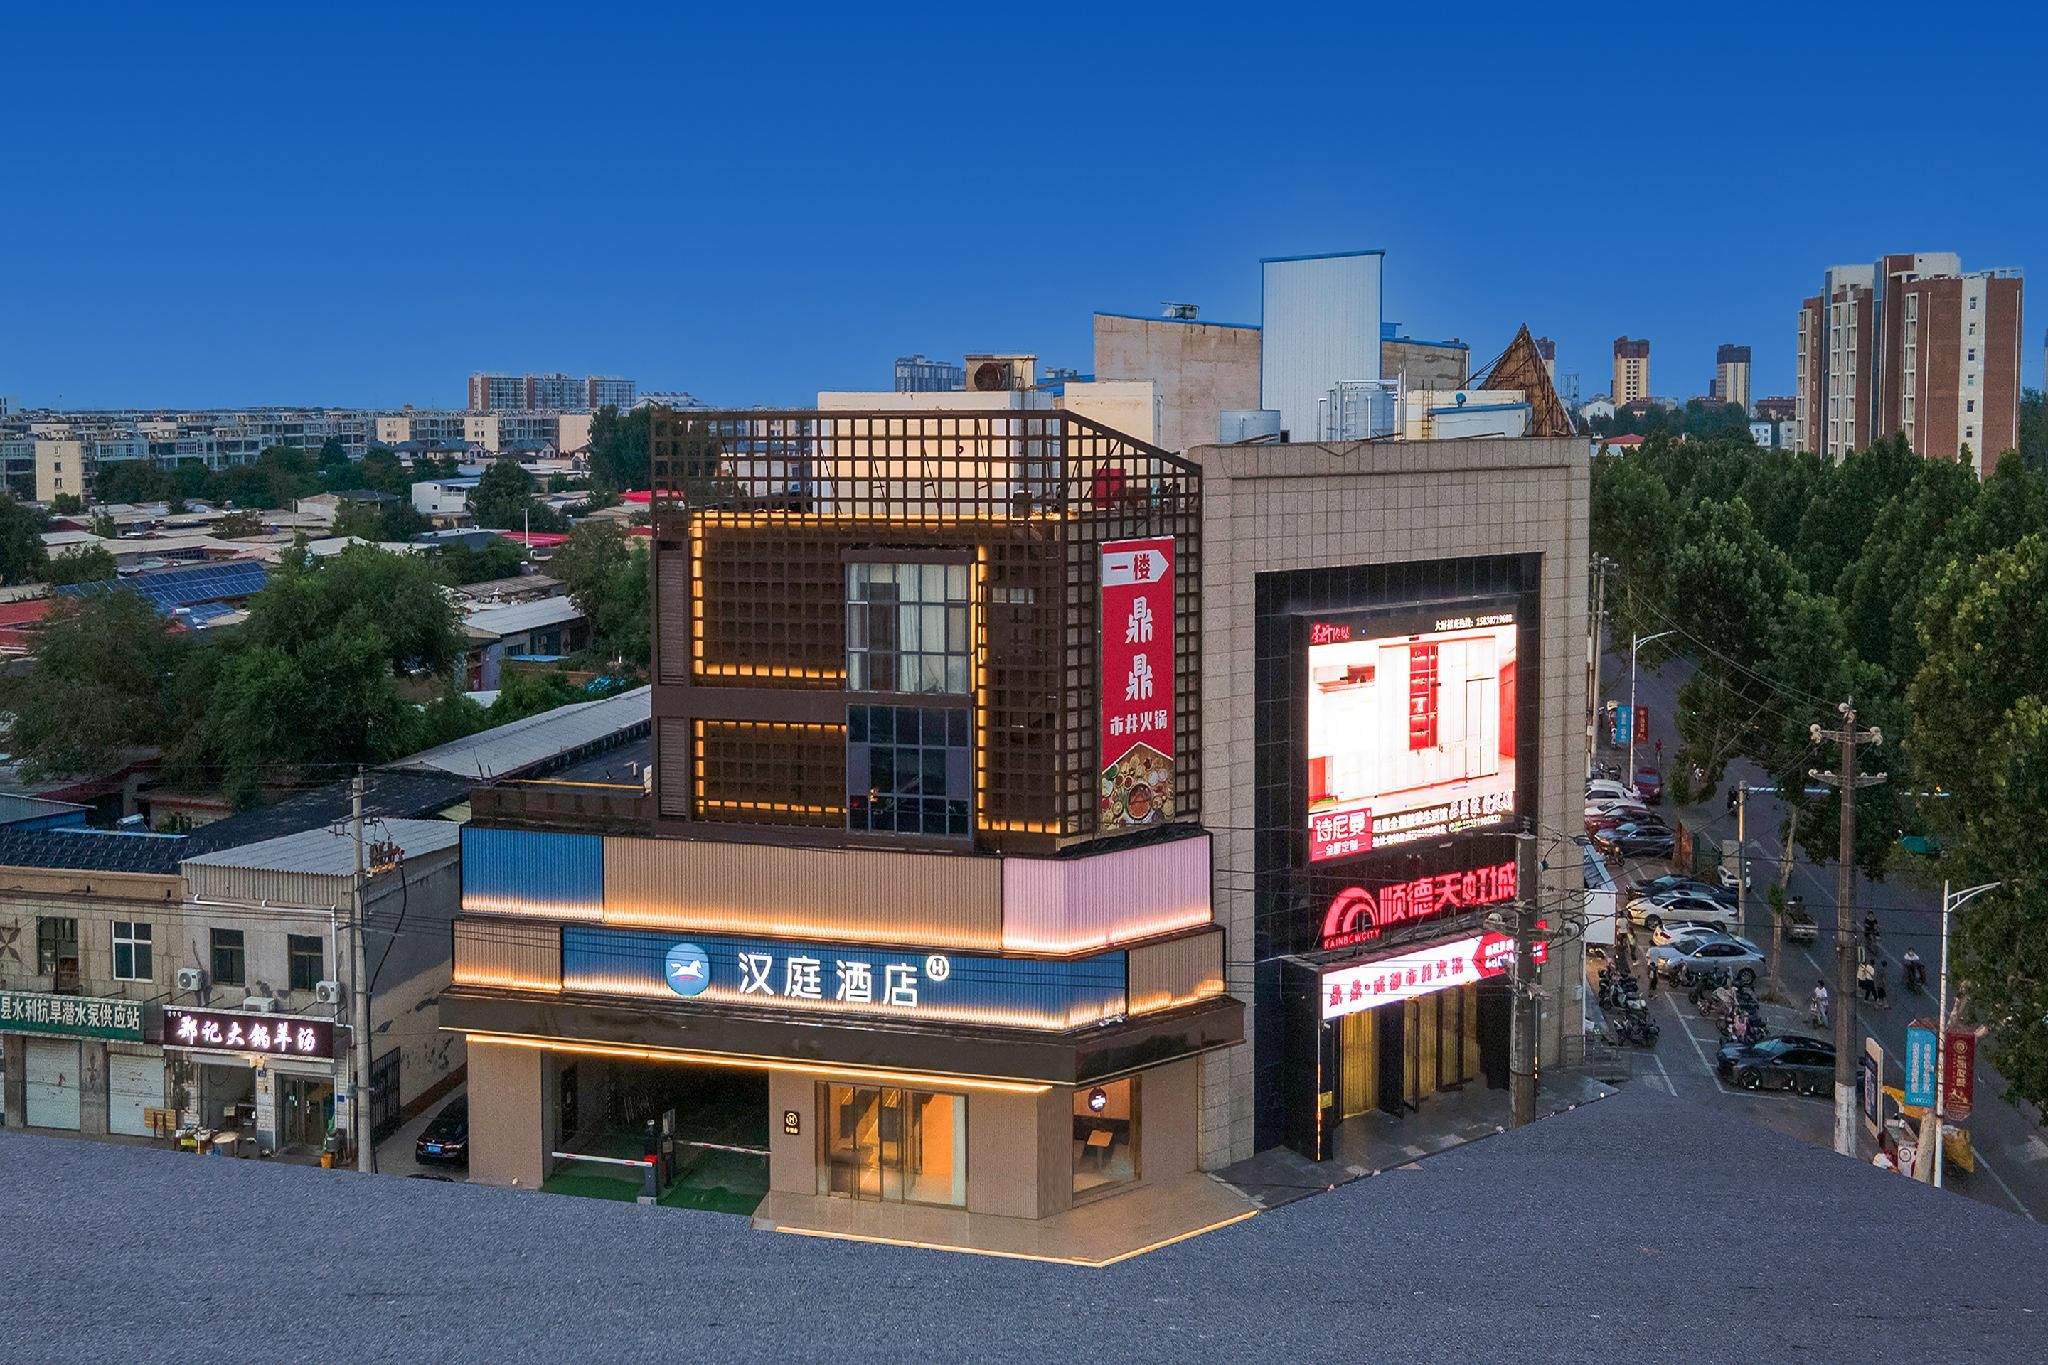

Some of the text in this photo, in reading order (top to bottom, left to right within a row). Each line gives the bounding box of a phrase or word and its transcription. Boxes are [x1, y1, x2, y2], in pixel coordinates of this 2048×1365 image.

[1109, 710, 1168, 736] 市井火锅
[1315, 812, 1366, 843] 诗尼曼
[1379, 861, 1517, 925] 顺德天虹城
[737, 952, 918, 1008] 汉庭酒店
